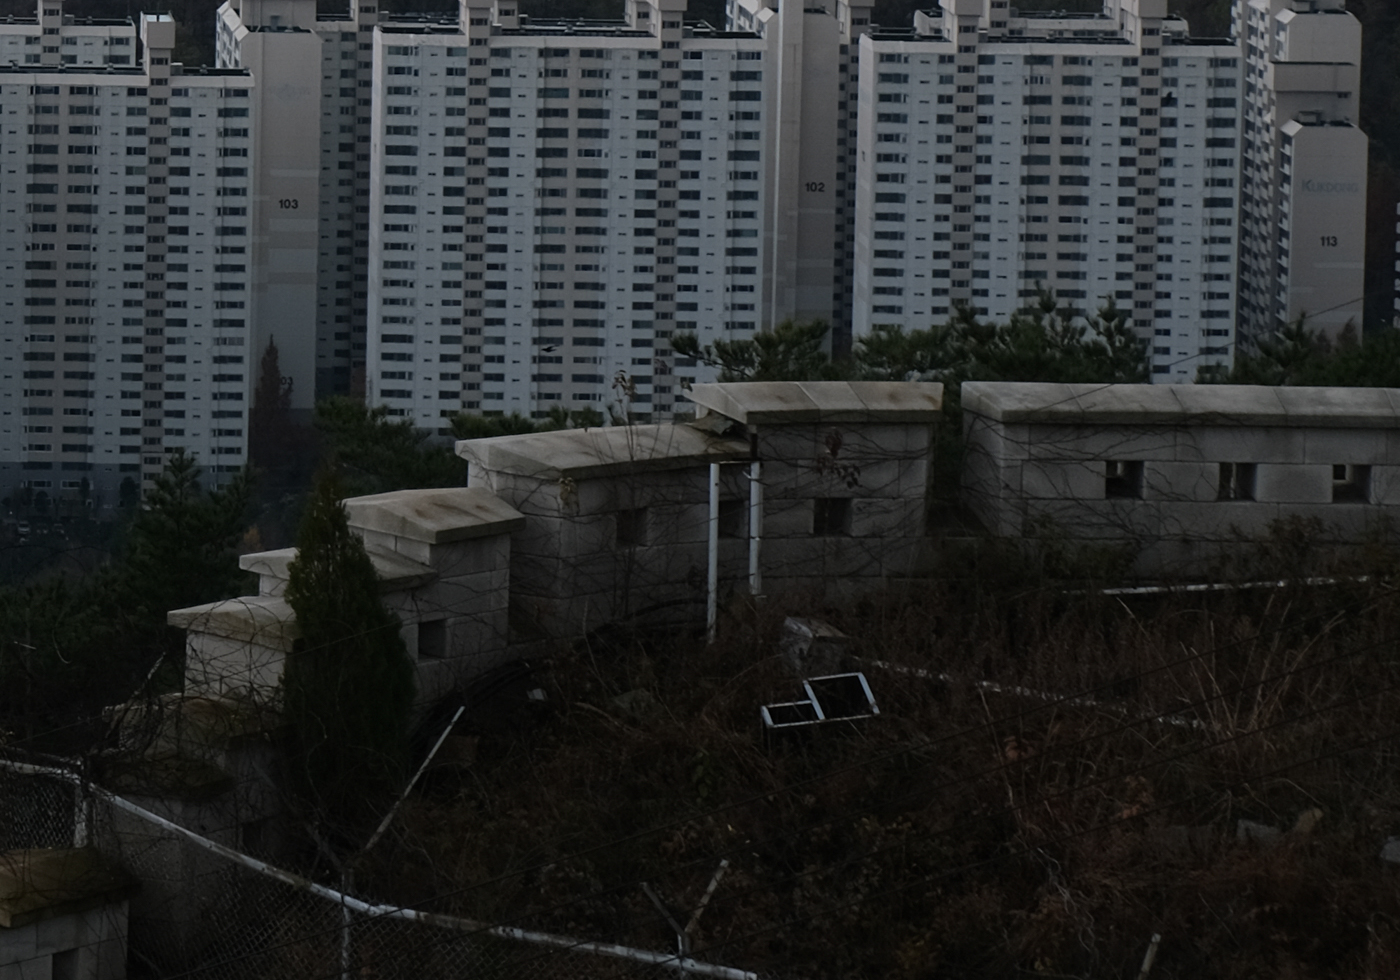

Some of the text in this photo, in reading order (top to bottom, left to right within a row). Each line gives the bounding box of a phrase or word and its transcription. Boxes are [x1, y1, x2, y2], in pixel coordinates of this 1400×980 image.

[805, 182, 825, 193] 102
[278, 198, 299, 210] 103
[1320, 236, 1338, 248] 113
